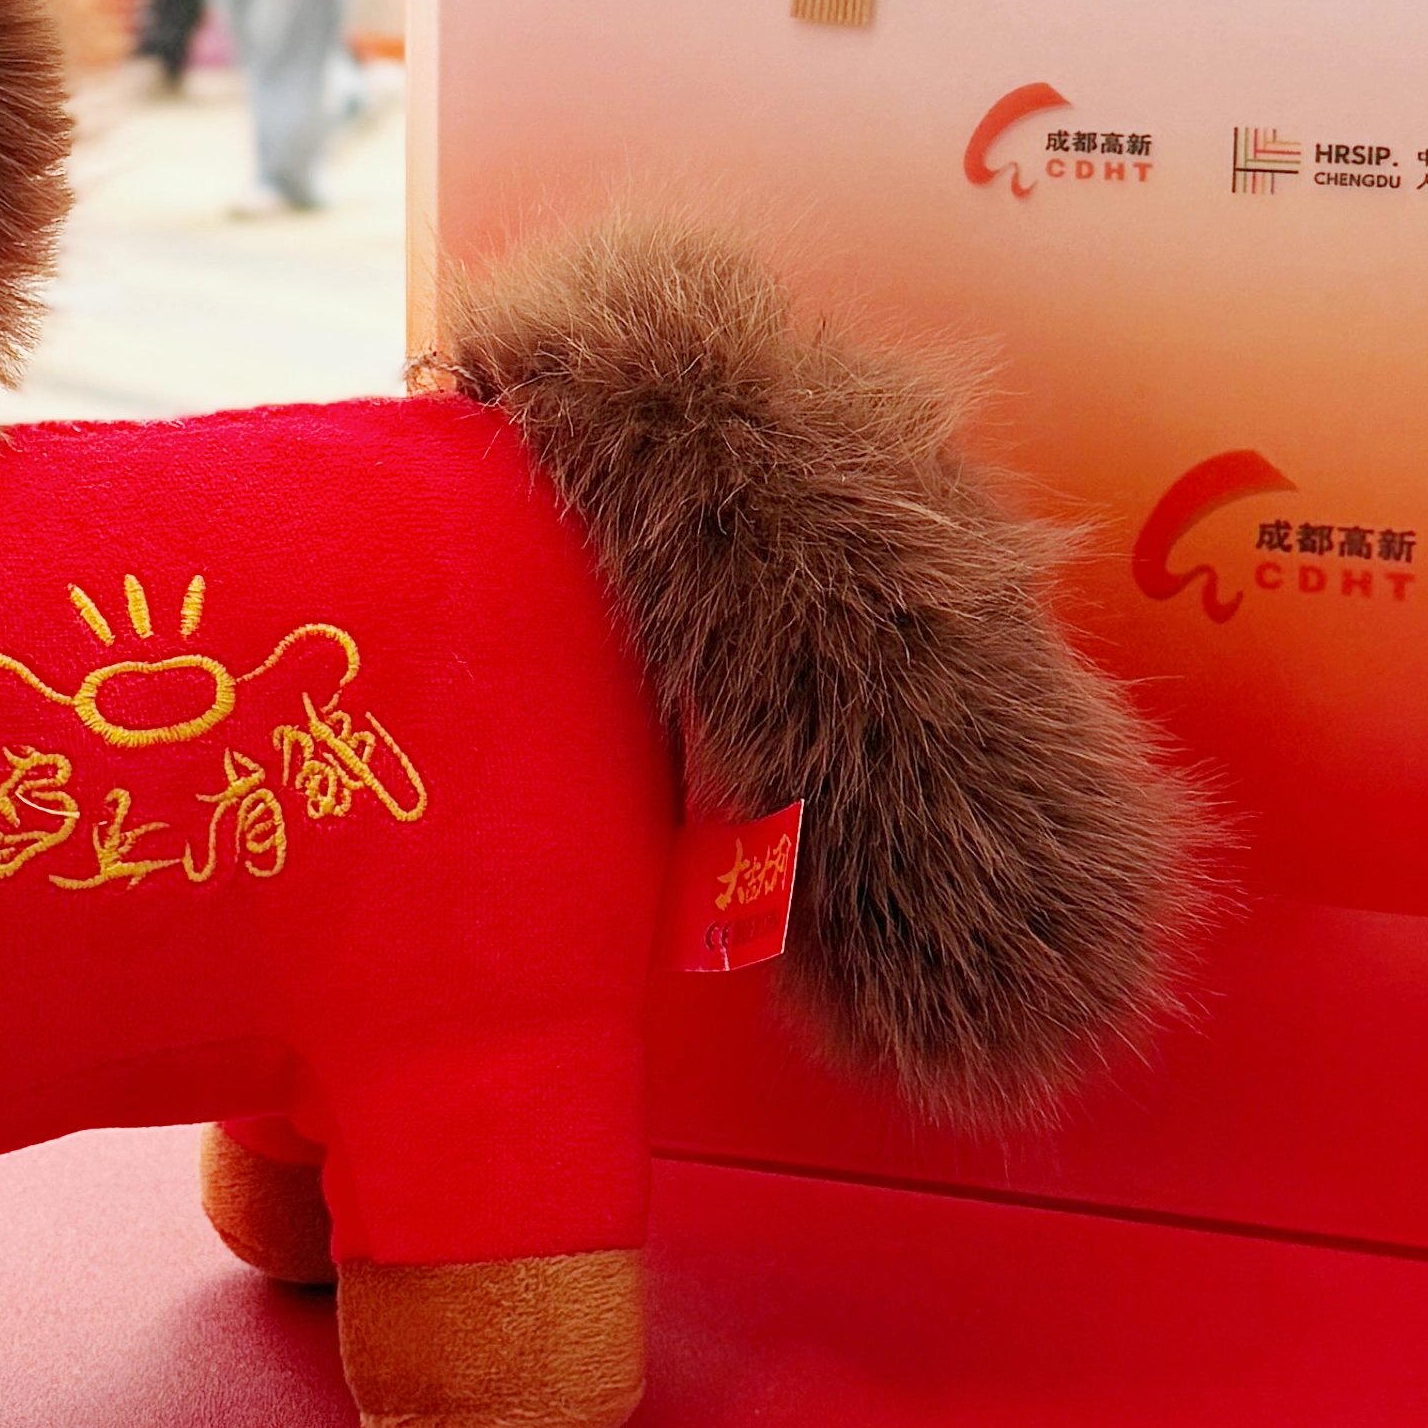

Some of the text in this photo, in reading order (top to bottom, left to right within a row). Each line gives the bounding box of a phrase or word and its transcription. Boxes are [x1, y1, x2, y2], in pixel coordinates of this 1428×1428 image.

[1045, 129, 1152, 156] 成都高新
[1314, 143, 1399, 167] HRSIP.
[1046, 158, 1153, 182] CDHT
[1314, 171, 1401, 189] CHENGDU
[1255, 519, 1416, 563] 成都高新
[1254, 561, 1415, 601] CDHT
